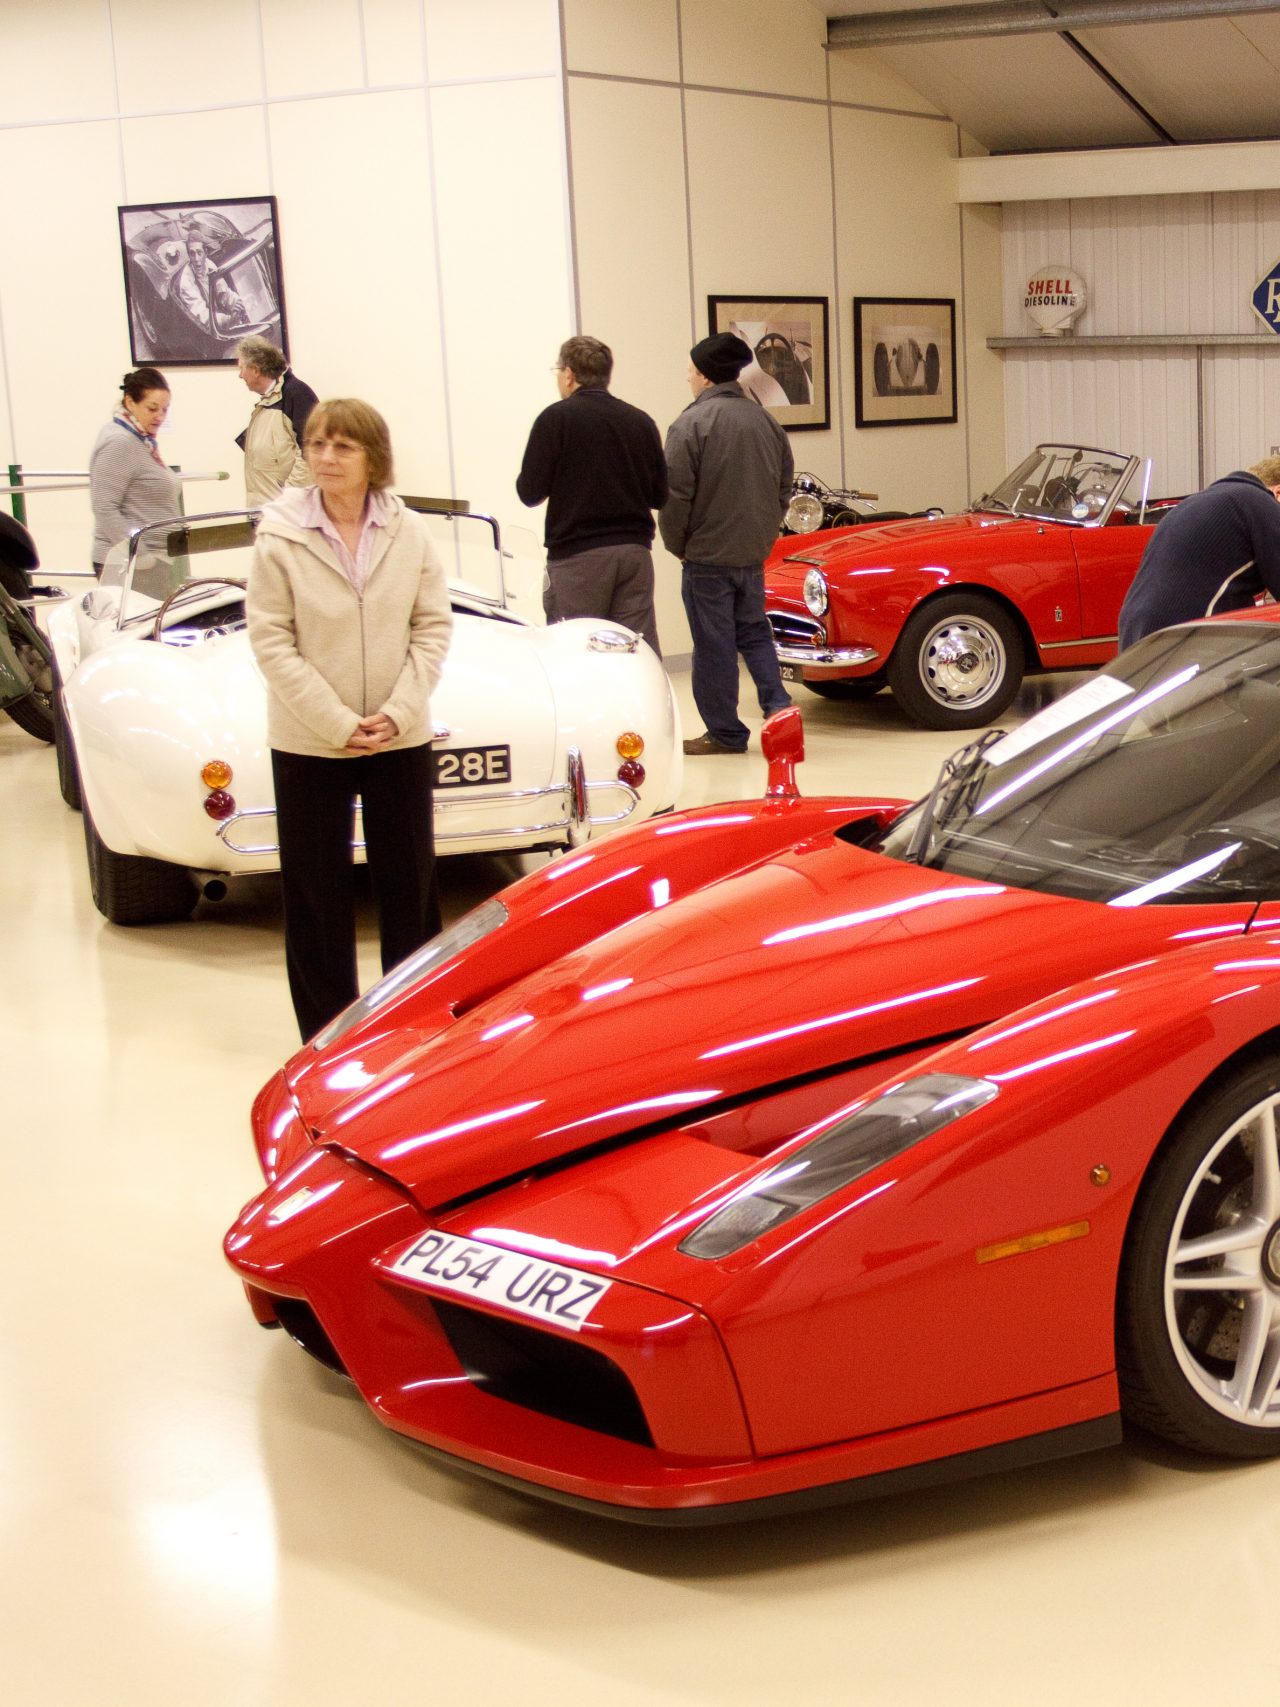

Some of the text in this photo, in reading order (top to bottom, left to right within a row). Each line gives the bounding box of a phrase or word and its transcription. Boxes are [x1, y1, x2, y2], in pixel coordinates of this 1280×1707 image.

[1028, 279, 1073, 296] SHELL
[1024, 295, 1077, 308] DIESOLINE
[438, 749, 508, 784] 28E
[400, 1233, 604, 1322] PL54 URZ
